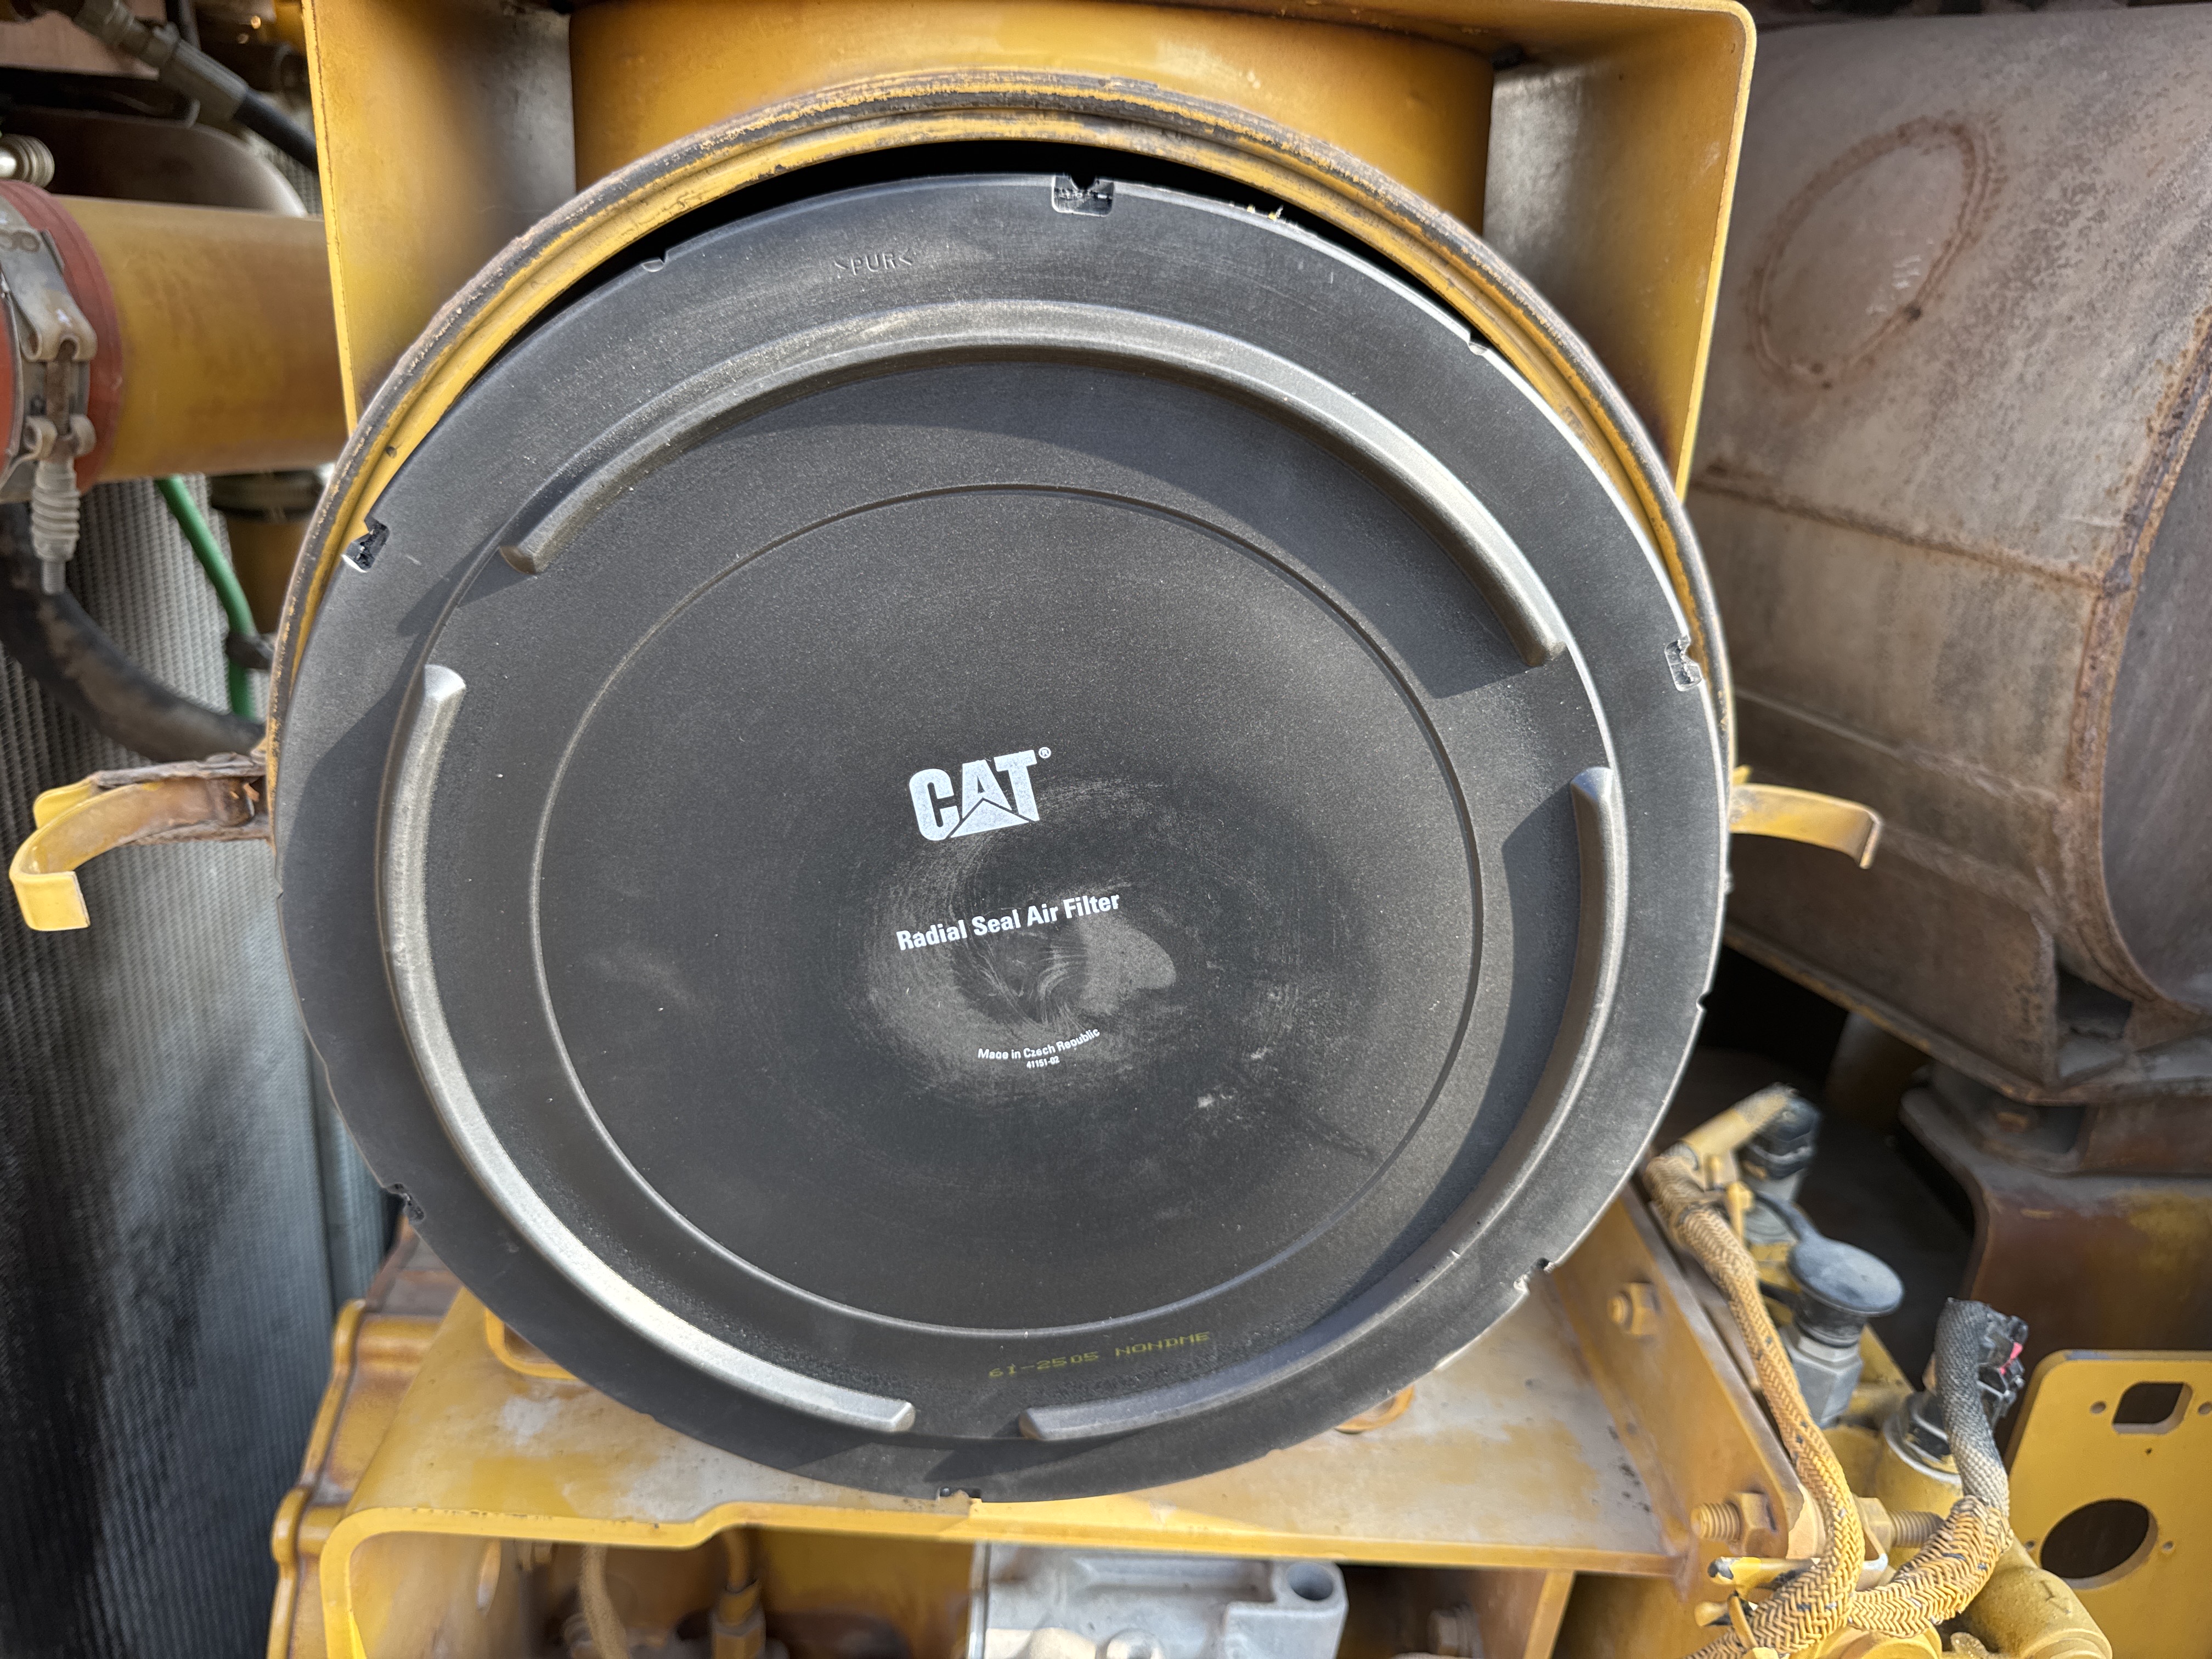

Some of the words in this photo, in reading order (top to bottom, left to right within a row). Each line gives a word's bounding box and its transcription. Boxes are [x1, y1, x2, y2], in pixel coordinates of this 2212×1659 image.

[896, 919, 967, 951] Radial
[972, 909, 1021, 936] Seal
[1026, 903, 1059, 926] Air
[1063, 894, 1120, 919] Filter
[978, 1048, 1009, 1059] Made
[1011, 1049, 1021, 1059] in
[1023, 1044, 1056, 1058] Czech
[1056, 1029, 1101, 1052] Republic
[1026, 1056, 1060, 1069] 41151-02
